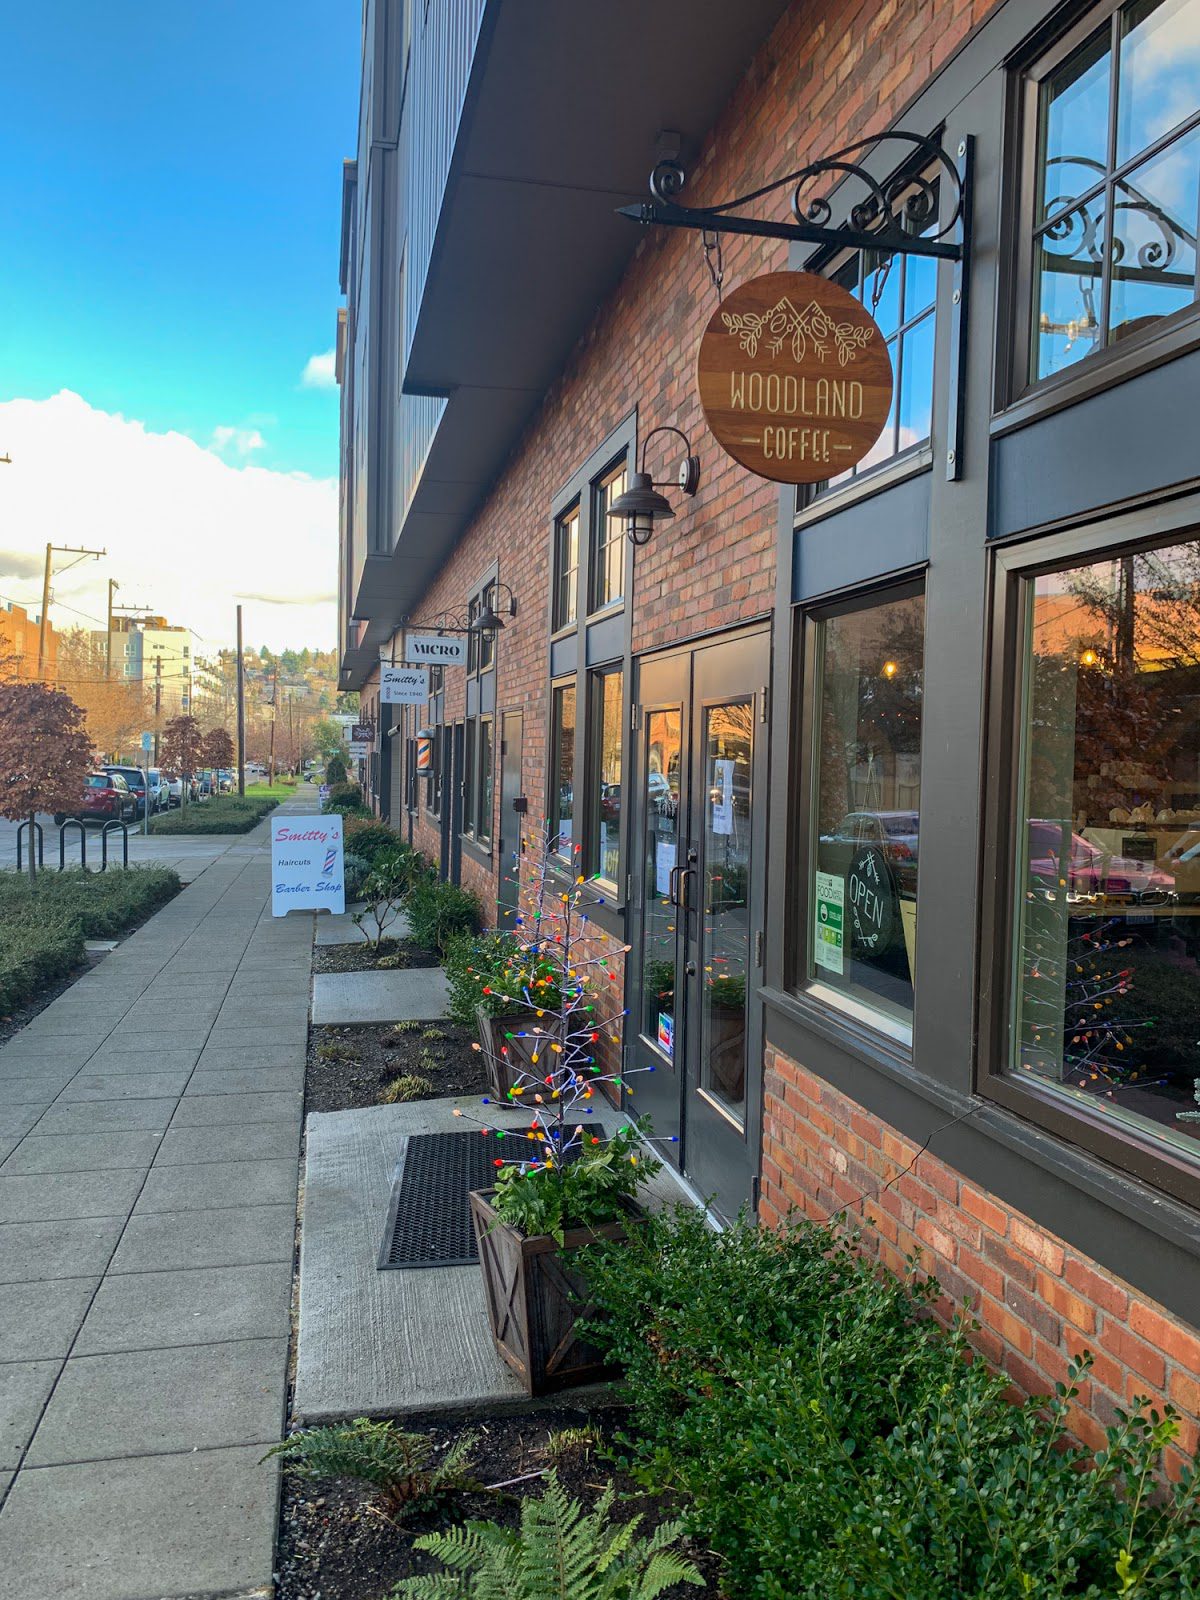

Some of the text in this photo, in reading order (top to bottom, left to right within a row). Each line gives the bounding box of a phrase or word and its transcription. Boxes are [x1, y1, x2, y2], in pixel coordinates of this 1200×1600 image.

[731, 371, 863, 419] WOODLAND
[764, 426, 830, 462] COFFEE
[414, 644, 460, 656] MICRO
[383, 673, 425, 685] Smitty's
[275, 827, 340, 843] Smitty's
[278, 859, 311, 867] Haircuts
[275, 882, 342, 893] Barber Shop
[849, 874, 884, 929] OPEN
